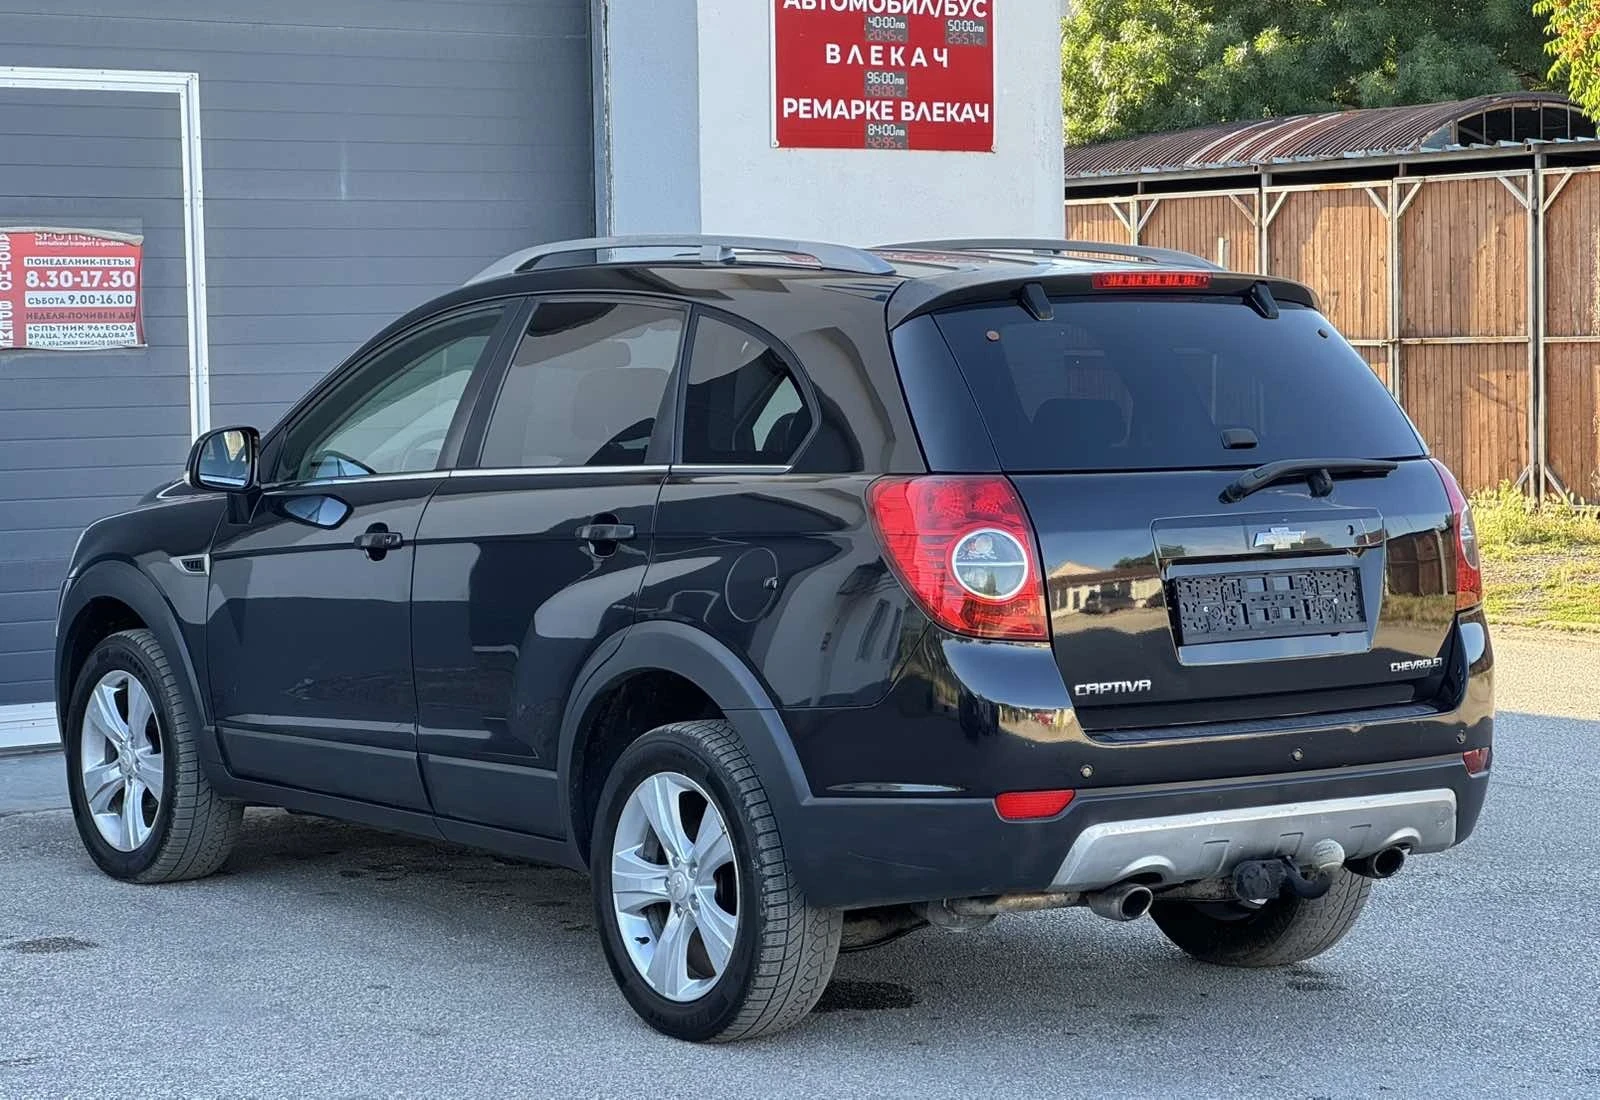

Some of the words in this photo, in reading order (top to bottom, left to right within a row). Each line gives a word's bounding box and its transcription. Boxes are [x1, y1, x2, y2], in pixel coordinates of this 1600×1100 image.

[783, 98, 894, 120] РЕМАРКЕ
[900, 101, 989, 123] ВЛЕКАЧ
[25, 270, 136, 288] 8.30-17.30
[28, 297, 66, 305] СЪБОТА
[68, 294, 132, 305] 9.00-16.00
[1390, 657, 1443, 672] CHEVROLET
[1074, 679, 1152, 696] CAPTIVA
